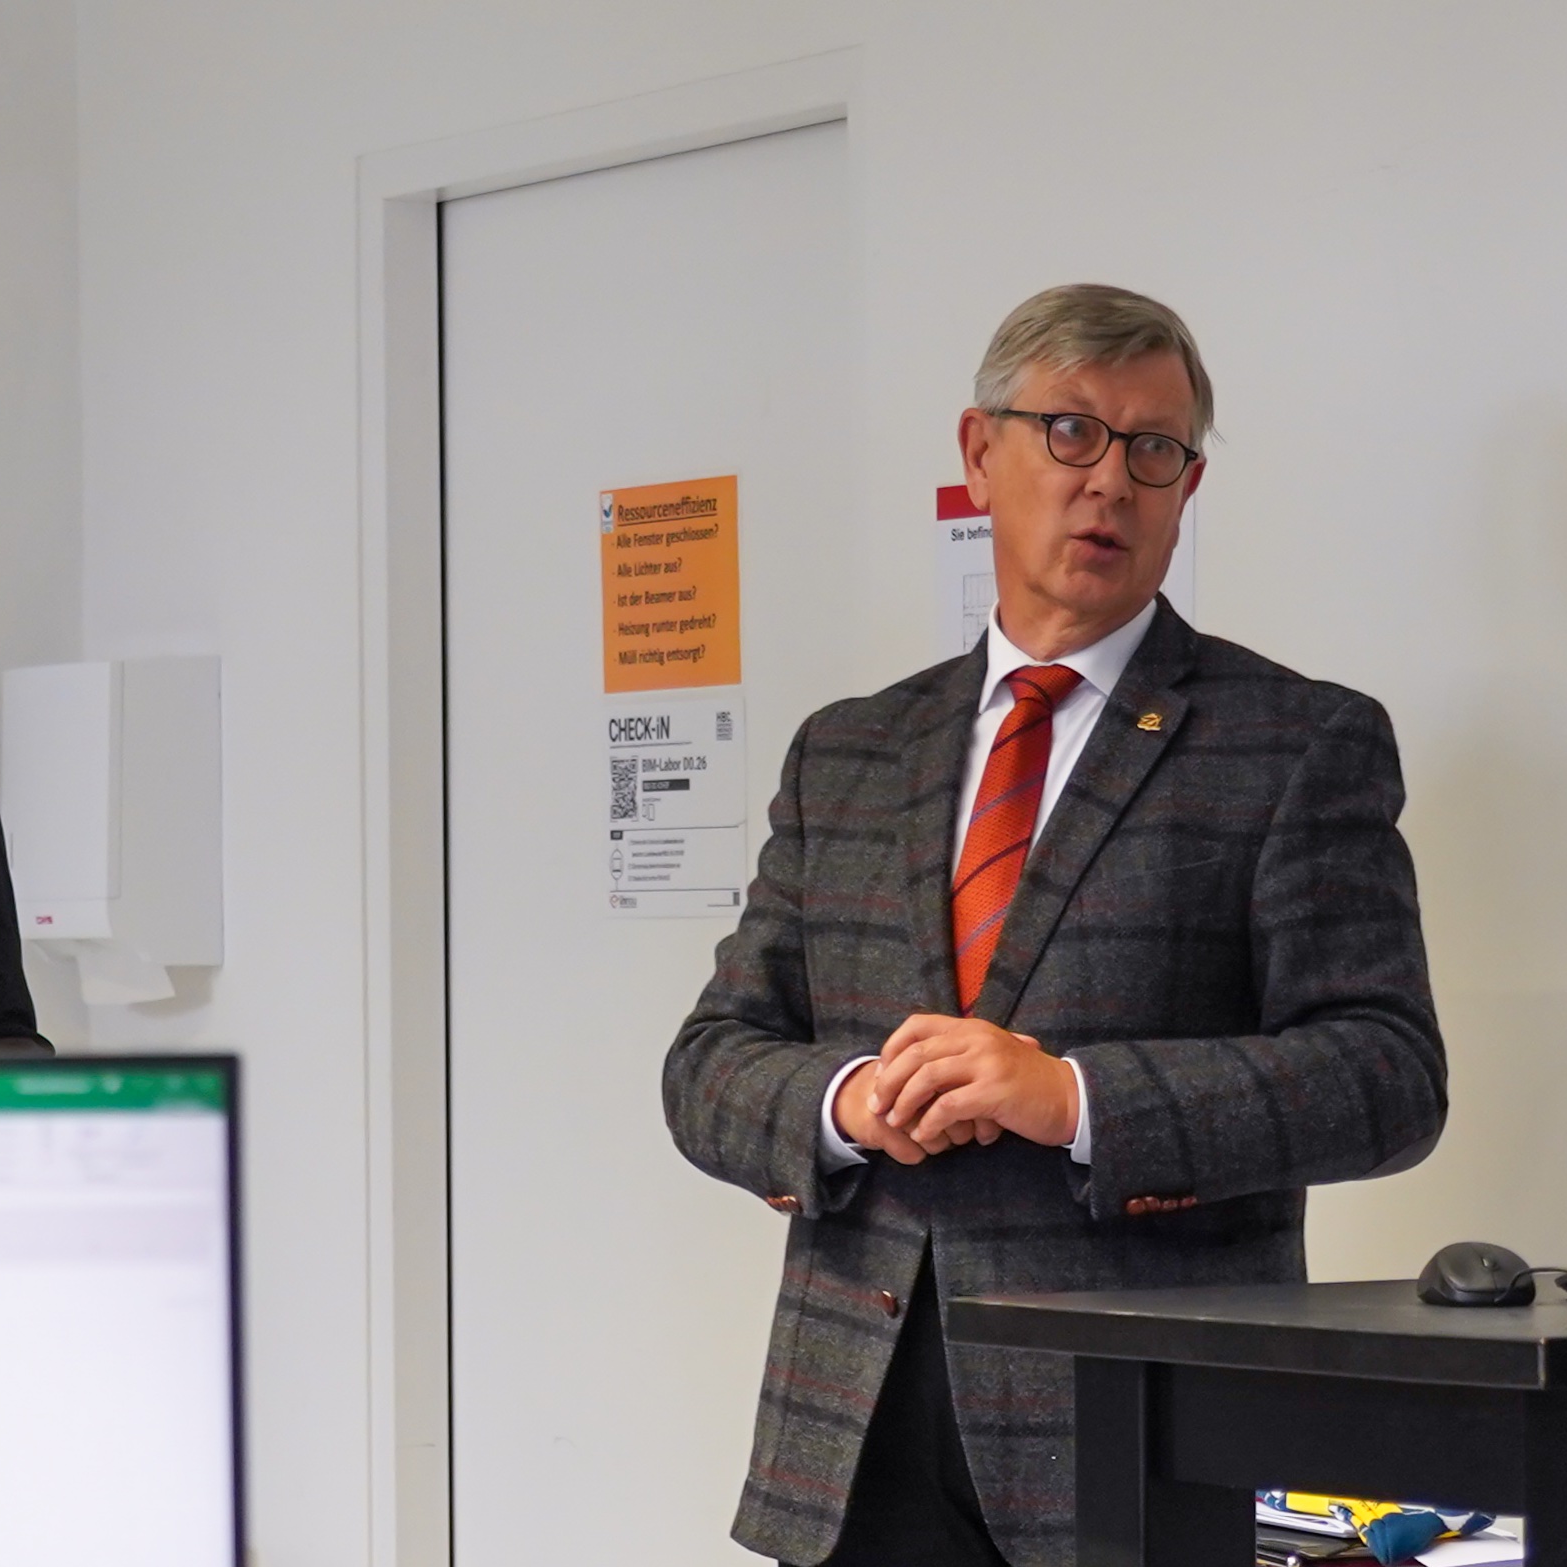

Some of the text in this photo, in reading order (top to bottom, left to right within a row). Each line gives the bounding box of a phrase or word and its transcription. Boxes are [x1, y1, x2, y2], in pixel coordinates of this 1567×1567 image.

[617, 495, 718, 522] Ressourceneffizienz
[616, 523, 719, 550] Alle Fenster geschlossen?
[951, 528, 964, 541] Sie
[617, 557, 682, 578] Alle Lichter aus?
[617, 585, 697, 608] Ist der Beamer aus?
[618, 613, 717, 638] Heizung runter gedreht?
[639, 648, 665, 666] richtig
[666, 644, 706, 664] entsorgt?
[641, 757, 682, 773] BIM-Labor
